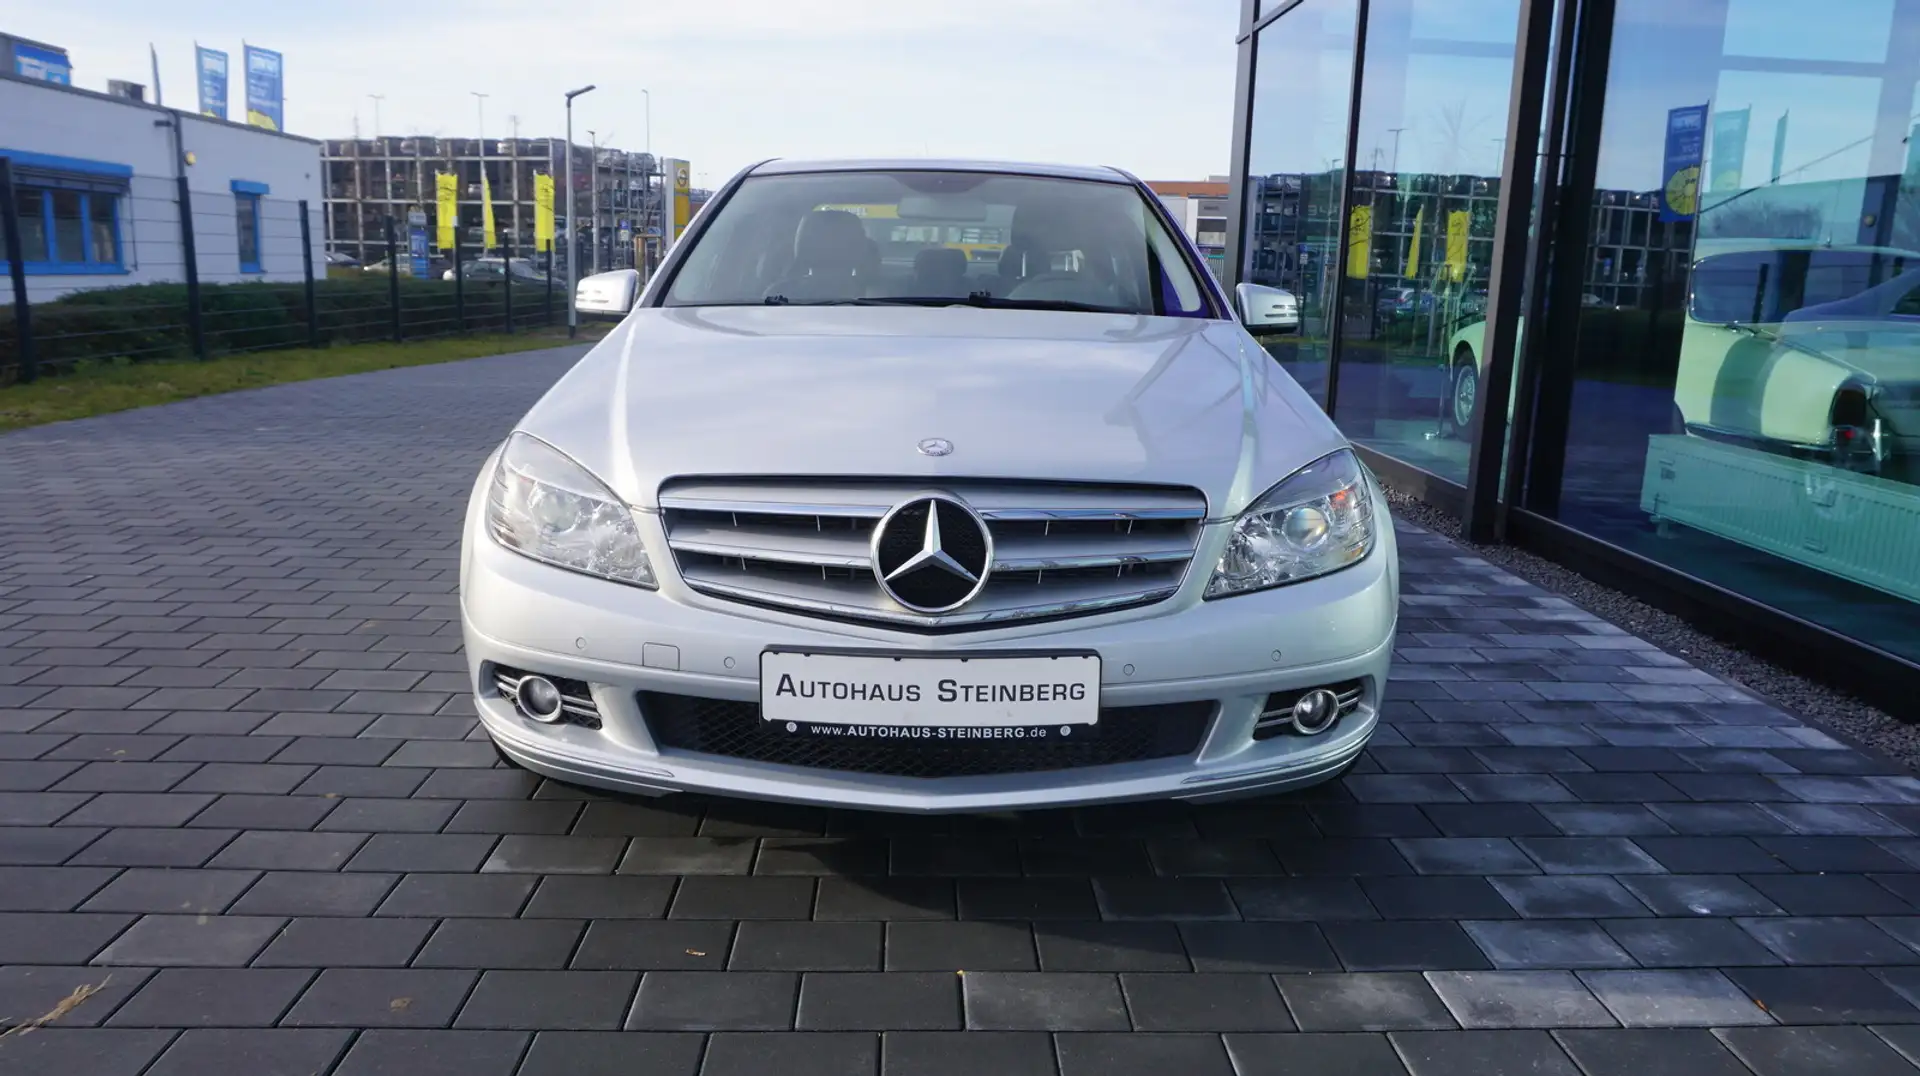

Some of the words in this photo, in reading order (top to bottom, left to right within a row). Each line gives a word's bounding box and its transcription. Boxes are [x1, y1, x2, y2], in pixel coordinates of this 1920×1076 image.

[776, 673, 921, 702] AUTOHAUS
[937, 679, 1086, 702] STEINBERG
[811, 724, 1048, 739] www.AUTOHAUS-STEINBERG.de
